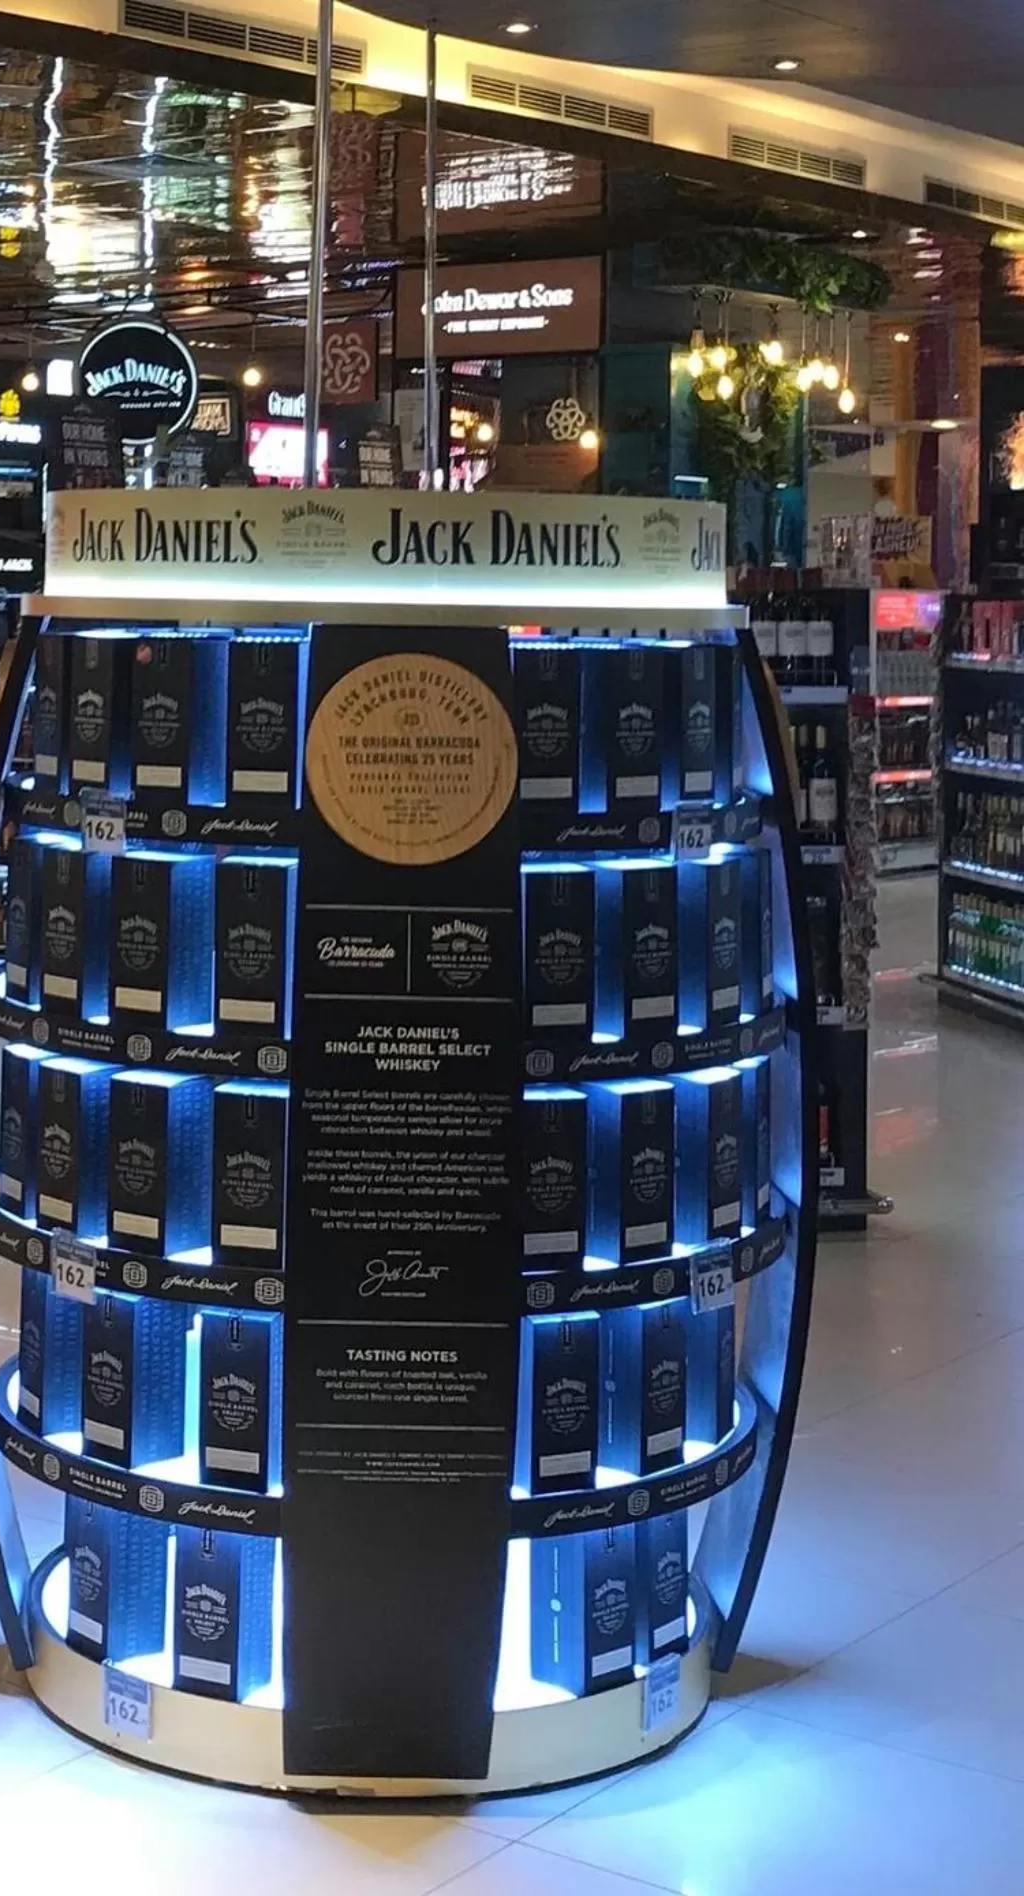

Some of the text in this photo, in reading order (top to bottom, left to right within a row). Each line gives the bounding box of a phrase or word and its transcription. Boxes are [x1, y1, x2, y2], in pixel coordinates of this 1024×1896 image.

[531, 284, 574, 307] Sons
[84, 364, 126, 397] JACK
[72, 508, 260, 565] JACK DANIEL'S
[371, 507, 624, 569] JACK DANIEL'S
[339, 735, 480, 749] THE ORIGINAL BARRACUDA
[345, 752, 418, 765] CELEBRATING
[440, 753, 475, 766] YEARS
[85, 821, 115, 841] 162
[679, 828, 705, 849] 162
[317, 936, 396, 960] Barracuda
[357, 1026, 460, 1040] JACK DANIEL'S
[325, 1041, 492, 1057] SINGLE BARREL SELECT
[375, 1058, 441, 1072] WHISKEY
[57, 1263, 85, 1289] 162
[698, 1273, 725, 1298] 162
[346, 1349, 458, 1363] TASTING NOTES
[109, 1698, 140, 1724] 162
